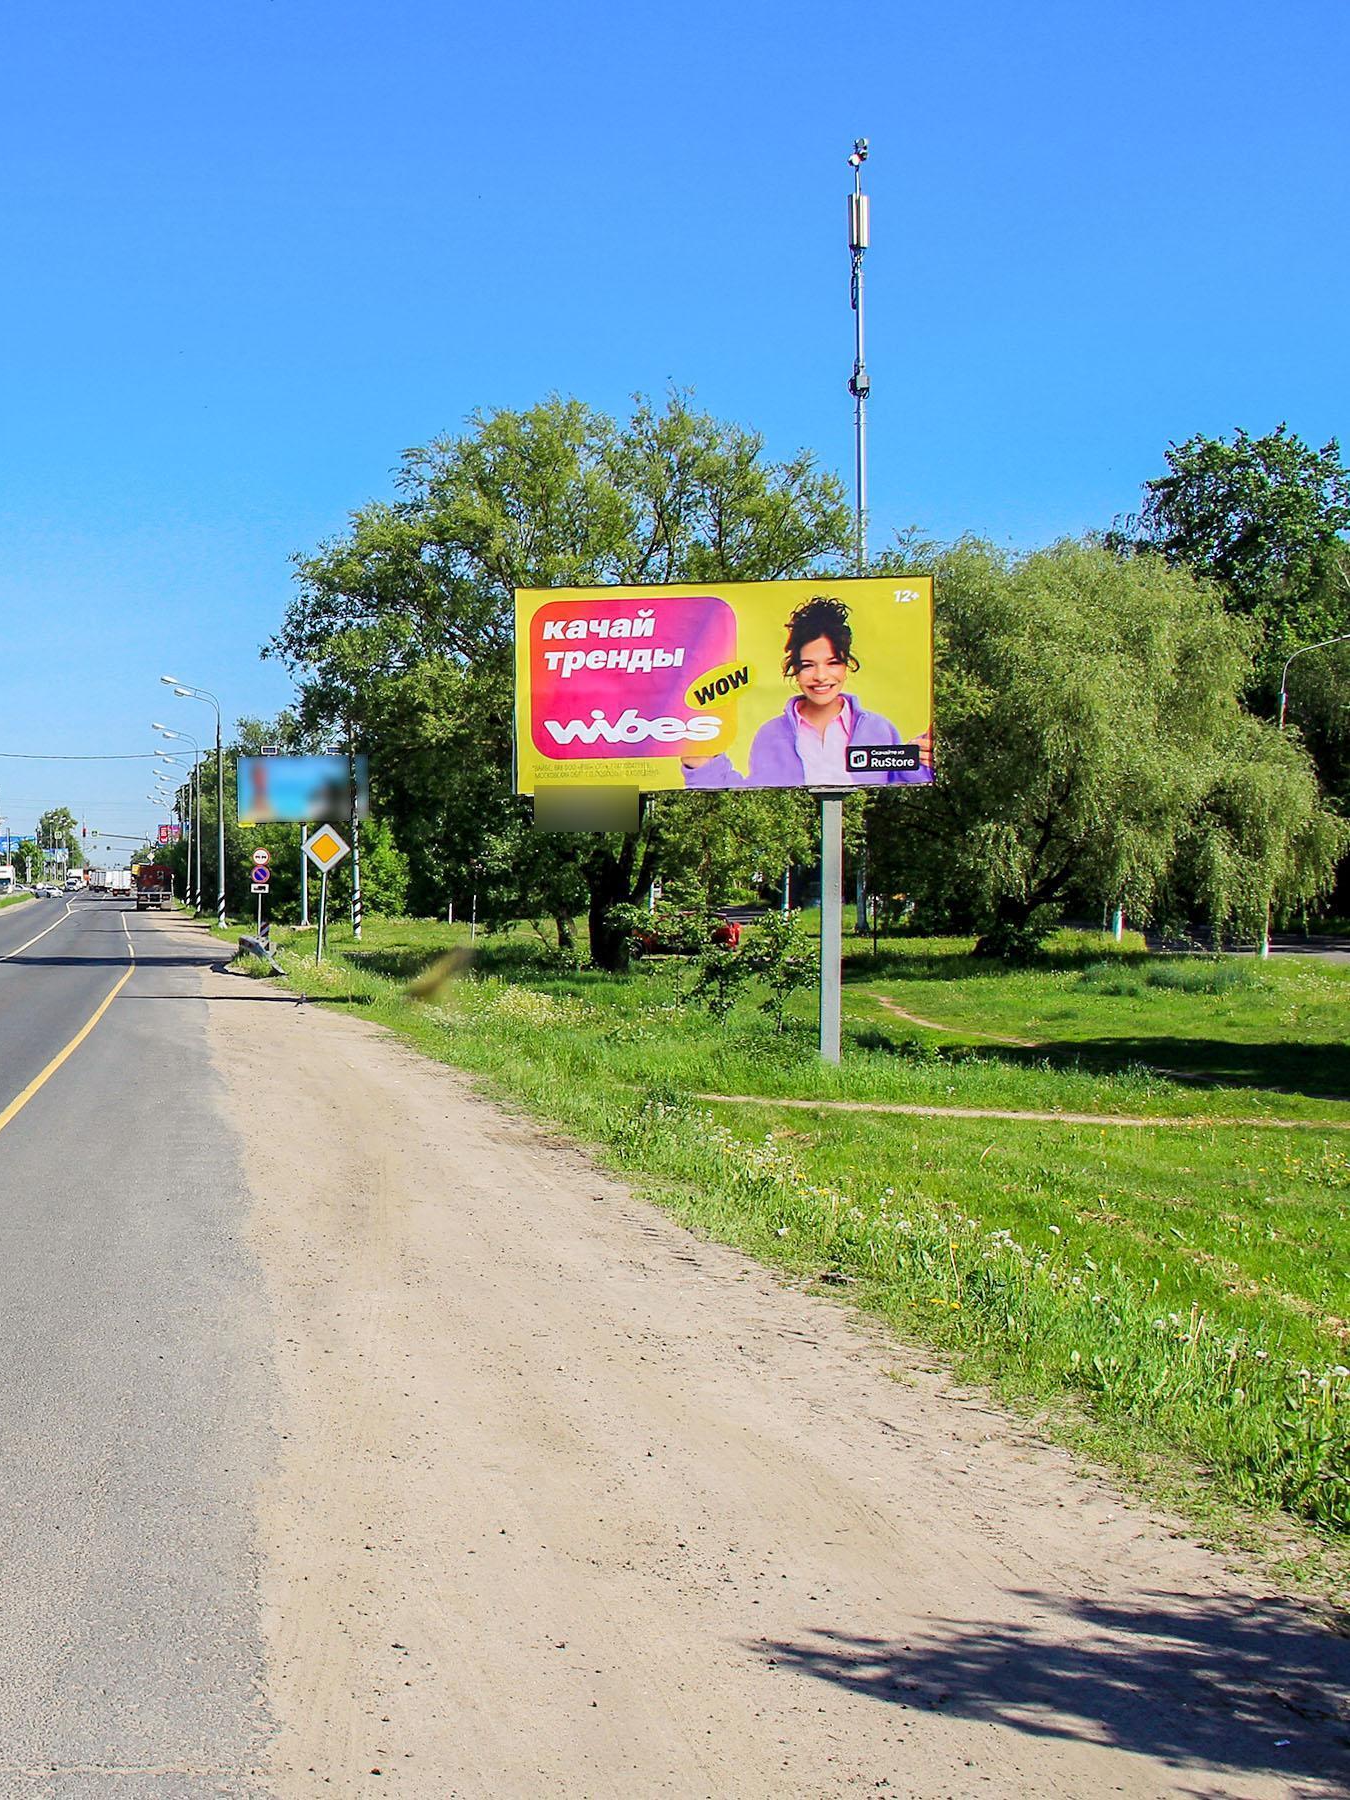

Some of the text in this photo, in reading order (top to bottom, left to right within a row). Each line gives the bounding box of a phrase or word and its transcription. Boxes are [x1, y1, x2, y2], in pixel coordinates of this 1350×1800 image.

[893, 590, 920, 602] 12+
[542, 608, 656, 640] качай
[544, 647, 685, 678] тренды
[543, 709, 722, 745] wibes
[871, 757, 915, 767] RuStore
